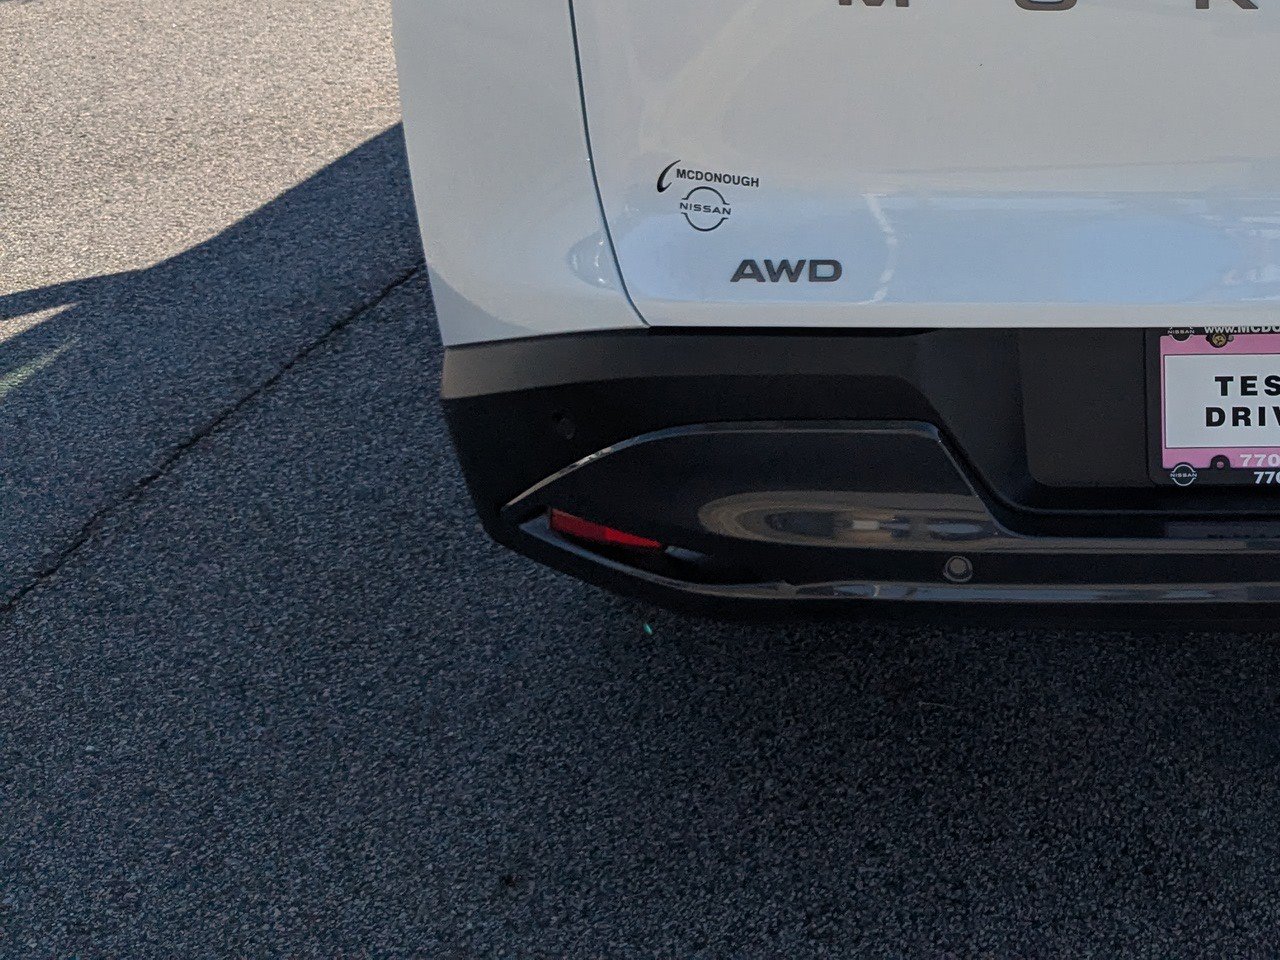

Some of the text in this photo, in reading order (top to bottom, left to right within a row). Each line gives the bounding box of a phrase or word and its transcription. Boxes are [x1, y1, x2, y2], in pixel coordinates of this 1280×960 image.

[676, 168, 760, 188] MCDONOUGH
[679, 202, 732, 216] NISSAN
[730, 259, 843, 283] AWD
